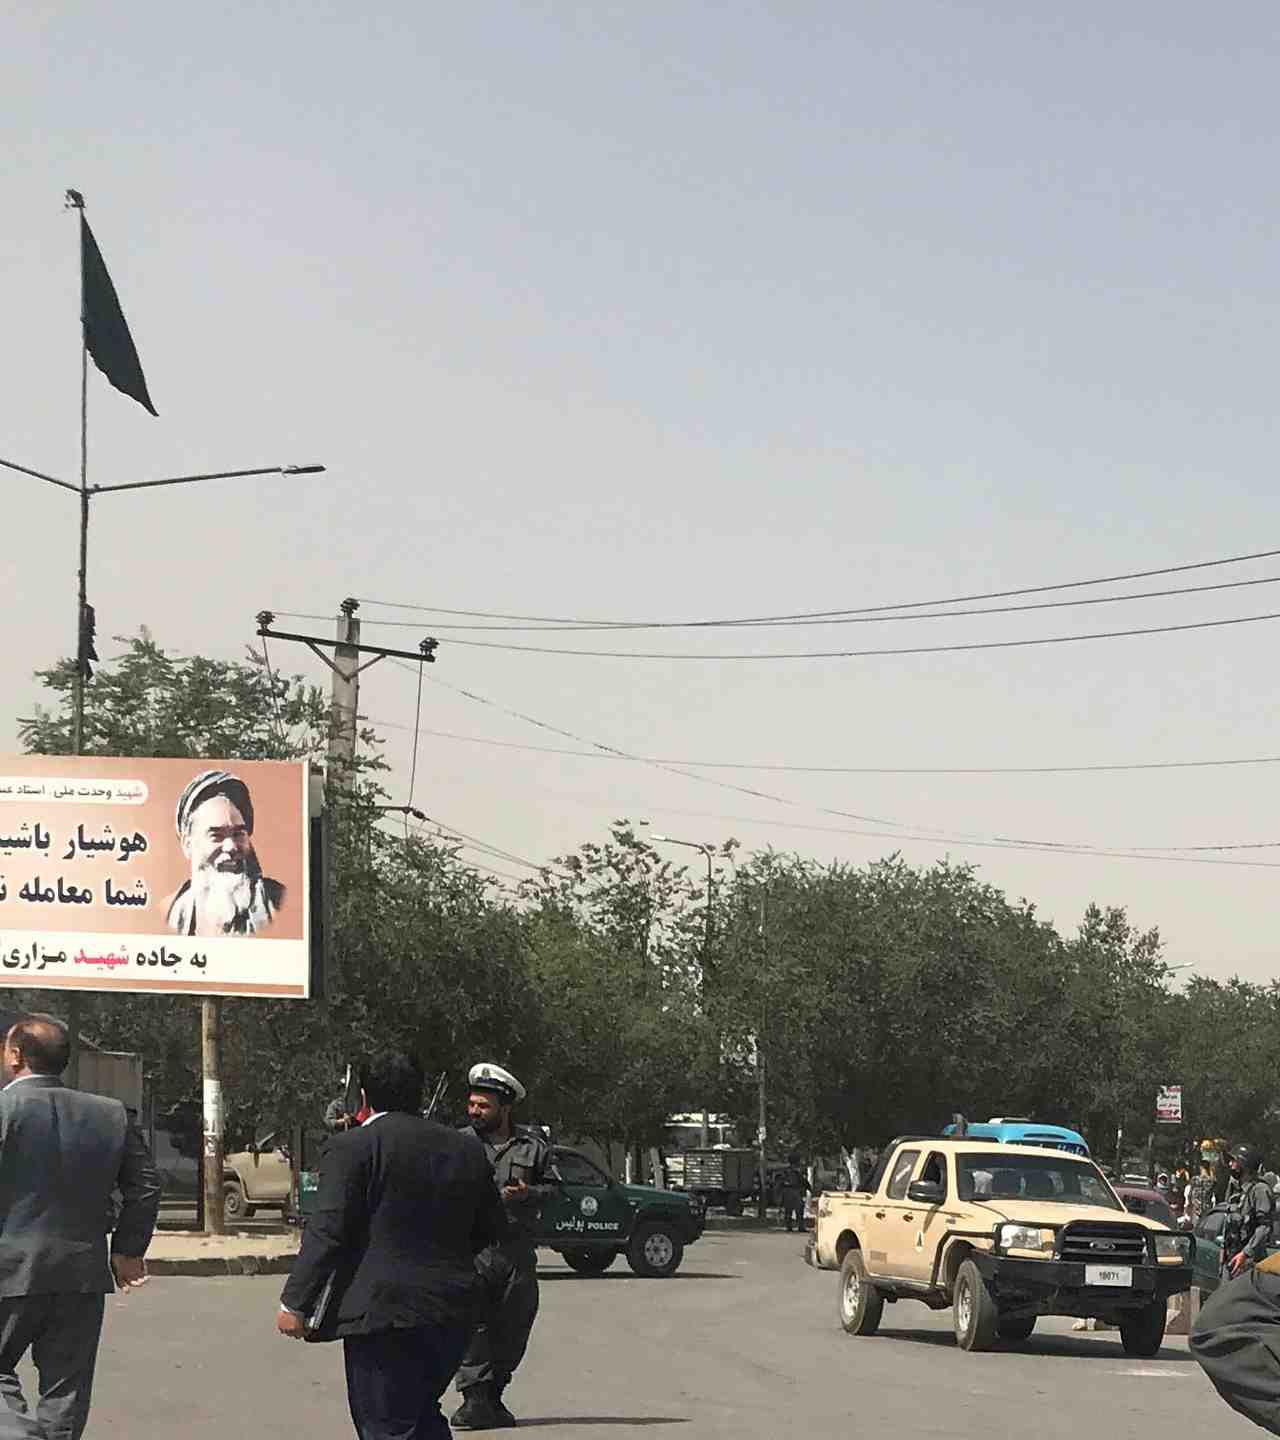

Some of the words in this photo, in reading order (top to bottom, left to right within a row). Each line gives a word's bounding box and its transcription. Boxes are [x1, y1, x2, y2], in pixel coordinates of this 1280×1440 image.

[0, 822, 50, 857] باشی
[62, 824, 148, 861] هوشیار
[19, 876, 93, 904] معامله
[105, 878, 148, 906] شما
[2, 942, 67, 970] مزاری
[73, 945, 130, 971] شهید
[136, 946, 182, 974] جاده
[190, 950, 207, 975] به
[587, 1221, 619, 1230] POLICE
